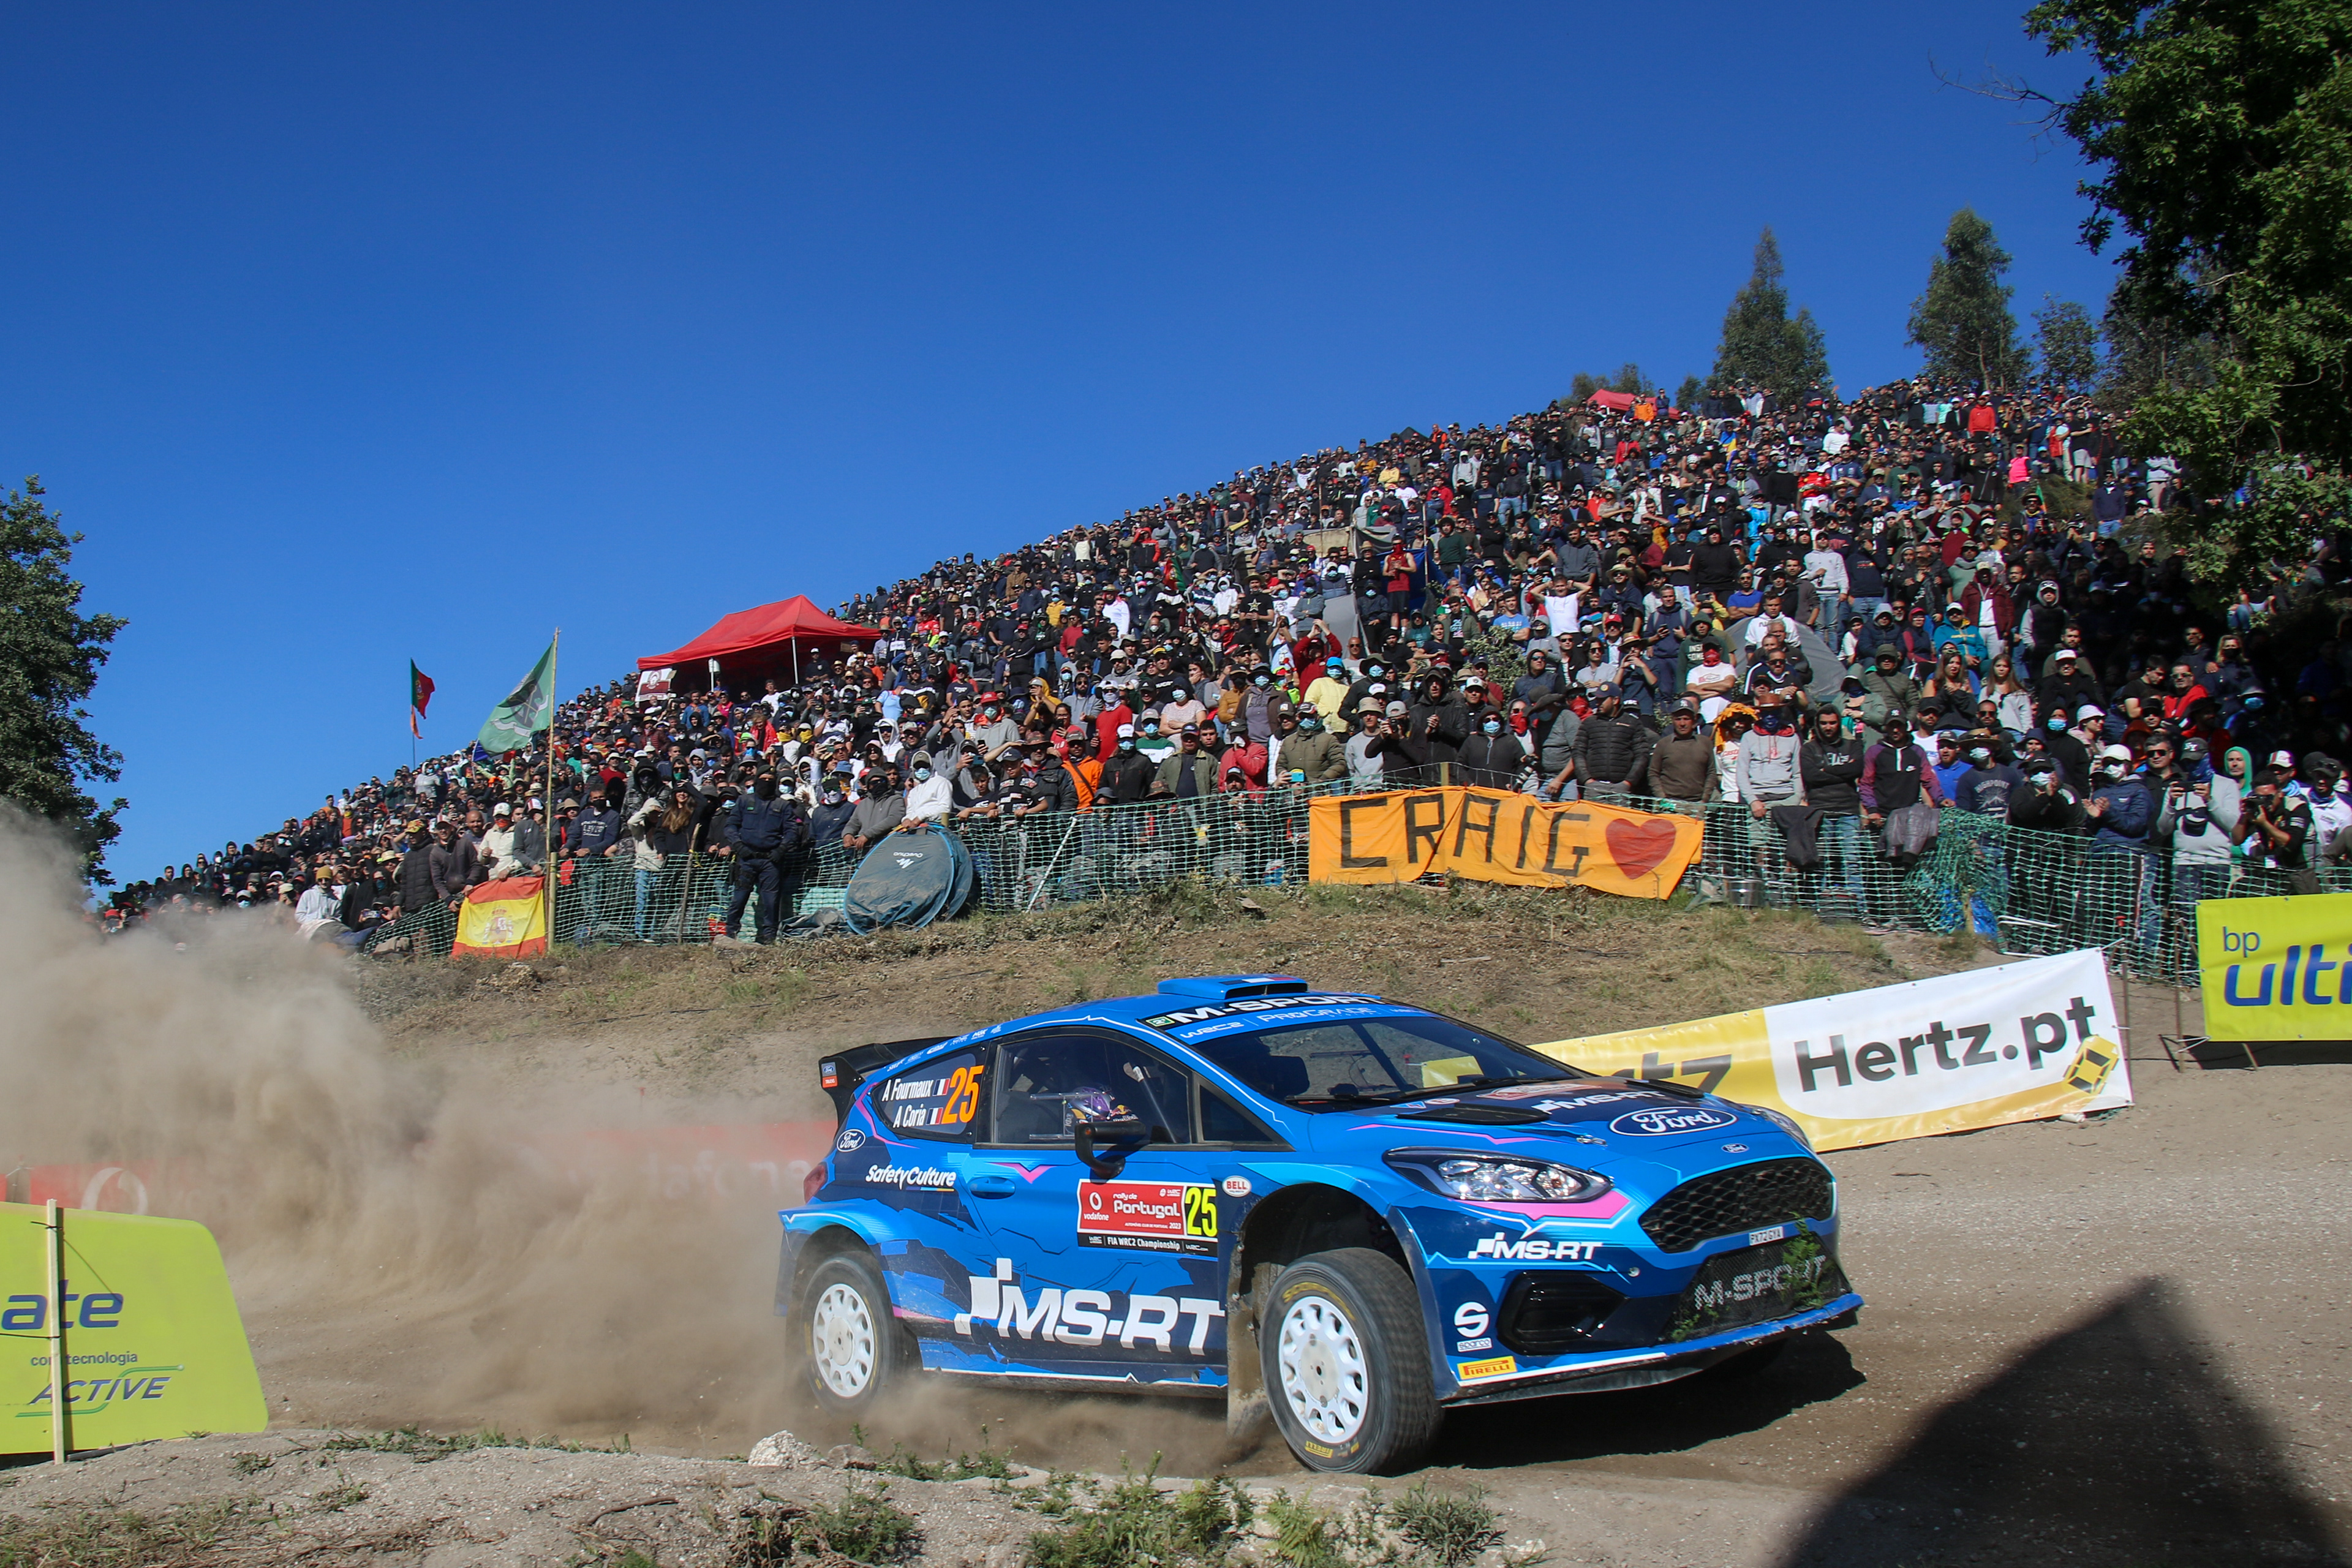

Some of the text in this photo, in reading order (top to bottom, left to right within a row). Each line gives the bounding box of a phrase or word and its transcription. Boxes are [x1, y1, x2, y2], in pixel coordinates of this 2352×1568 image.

[1341, 792, 1591, 878] CRAIG
[2223, 926, 2261, 958] bp
[1793, 997, 2096, 1092] Hertz.pt
[882, 1079, 933, 1102] A Fourmaux
[941, 1065, 984, 1124] 25
[892, 1103, 925, 1128] A Coria
[1632, 1109, 1722, 1133] Ford
[840, 1134, 859, 1148] Ford
[865, 1164, 957, 1190] SafetyCulture
[1227, 1181, 1247, 1189] BELL
[1084, 1212, 1109, 1221] vodafone
[1114, 1199, 1181, 1218] Portugal
[1185, 1187, 1218, 1237] 25
[1107, 1236, 1180, 1251] FIA WRC2 Championship
[1459, 1339, 1490, 1348] sparco
[66, 1351, 138, 1366] tecnologia
[1464, 1360, 1510, 1376] PIRELLI
